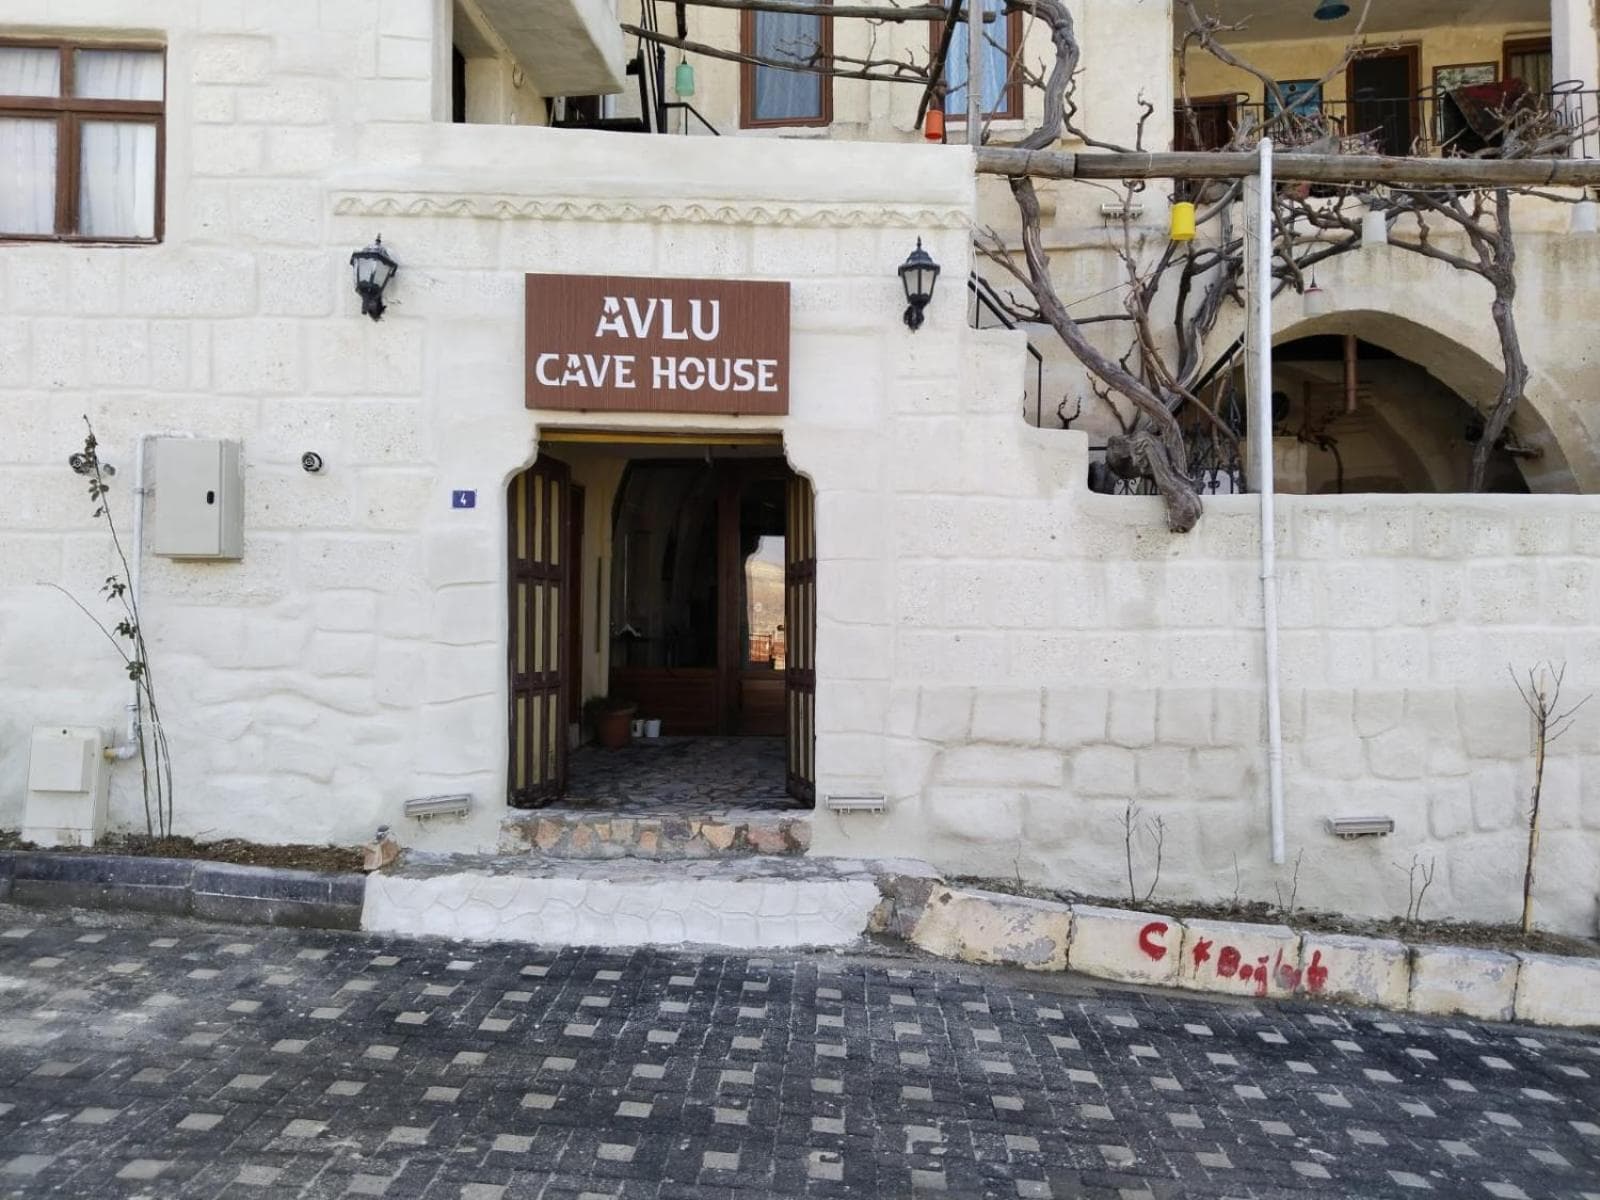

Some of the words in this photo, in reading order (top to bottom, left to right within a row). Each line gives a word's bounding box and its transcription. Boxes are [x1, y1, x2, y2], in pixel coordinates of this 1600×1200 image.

[595, 296, 720, 341] AVLU
[535, 353, 636, 388] CAVE
[651, 356, 778, 392] HOUSE
[460, 492, 467, 506] 4
